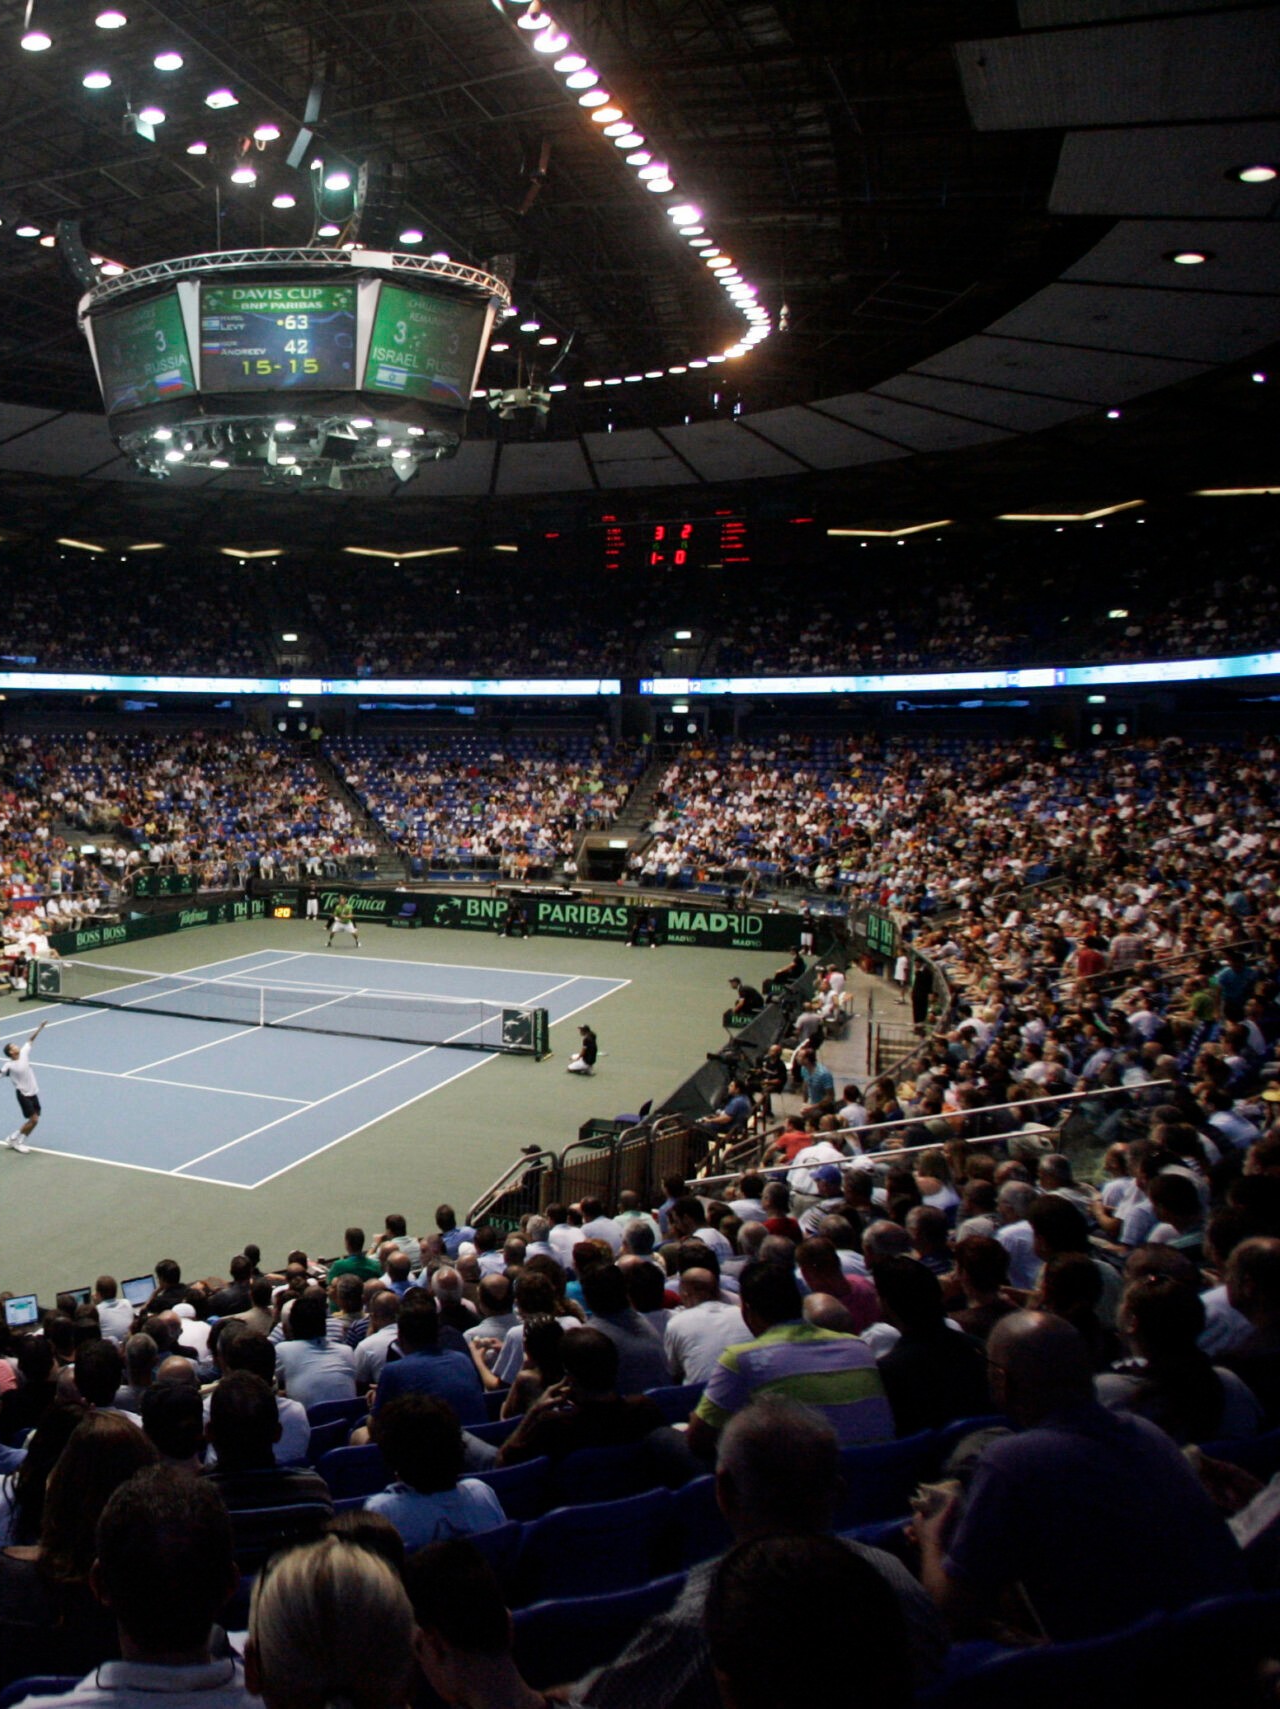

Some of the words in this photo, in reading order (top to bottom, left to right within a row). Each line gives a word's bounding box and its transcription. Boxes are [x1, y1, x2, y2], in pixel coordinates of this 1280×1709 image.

[231, 288, 283, 300] DAVIS
[287, 288, 323, 299] CUP
[241, 302, 268, 310] BNP
[270, 301, 323, 310] PARIBAS
[155, 330, 167, 352] 3
[393, 321, 407, 345] 3
[144, 353, 188, 376] RUSSIA
[372, 346, 419, 369] ISRAEL
[653, 525, 665, 541] 3
[680, 523, 693, 540] 2
[674, 550, 687, 565] 0
[279, 681, 290, 692] 10
[322, 681, 332, 692] 11
[642, 681, 653, 692] 11
[689, 681, 701, 692] 12
[466, 899, 509, 918] BNP
[538, 903, 628, 926] PARIBAS
[667, 910, 763, 935] MADRID
[76, 930, 100, 946] BOSS
[103, 926, 126, 941] BOSS
